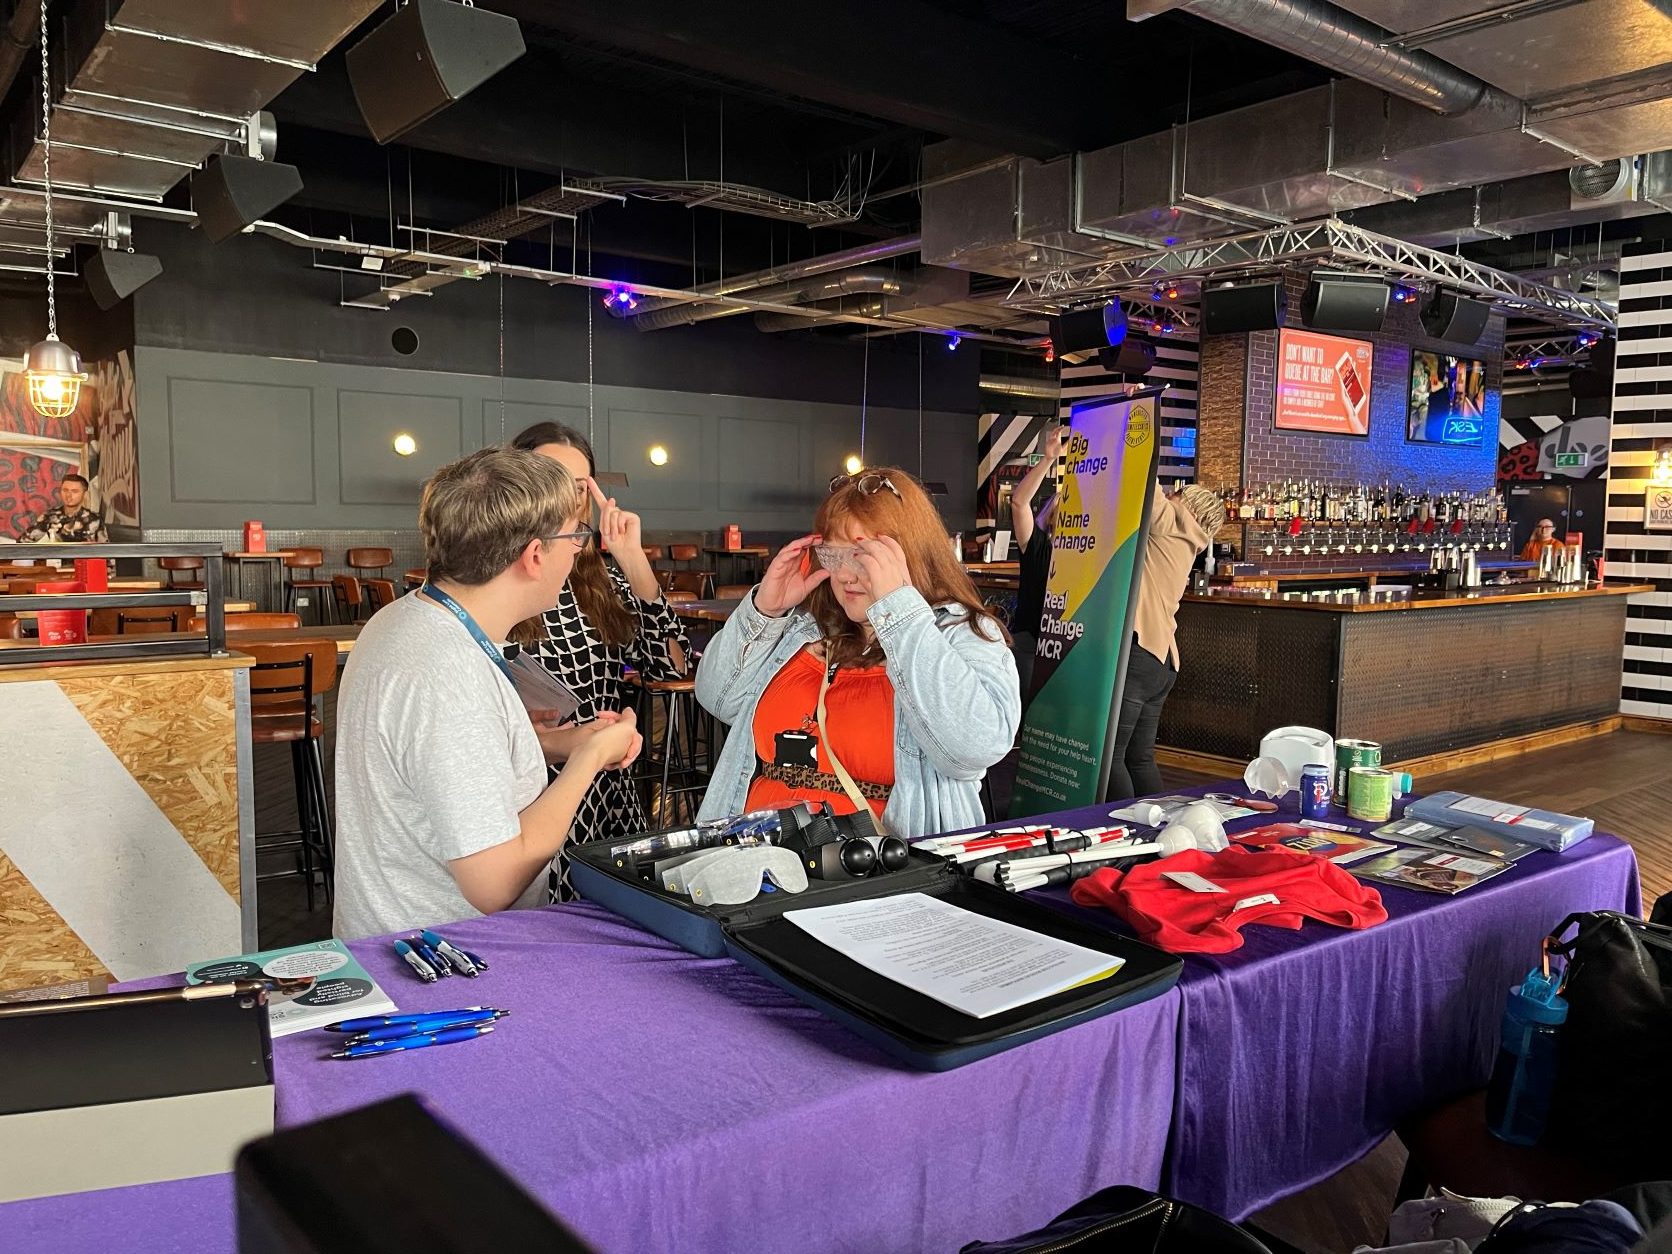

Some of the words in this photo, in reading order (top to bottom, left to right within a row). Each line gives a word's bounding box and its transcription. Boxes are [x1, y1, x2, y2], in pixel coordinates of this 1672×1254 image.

[1070, 435, 1089, 455] Big
[1066, 456, 1108, 475] change
[1057, 511, 1090, 528] Name
[1053, 532, 1096, 553] change
[1043, 590, 1069, 610] Real
[1040, 613, 1084, 640] Change
[1035, 637, 1062, 660] MCR
[1044, 732, 1055, 741] may
[1055, 734, 1068, 744] have
[1068, 738, 1090, 751] changed
[1058, 747, 1070, 755] your
[1046, 760, 1078, 778] experiencing
[1049, 771, 1068, 785] Donate
